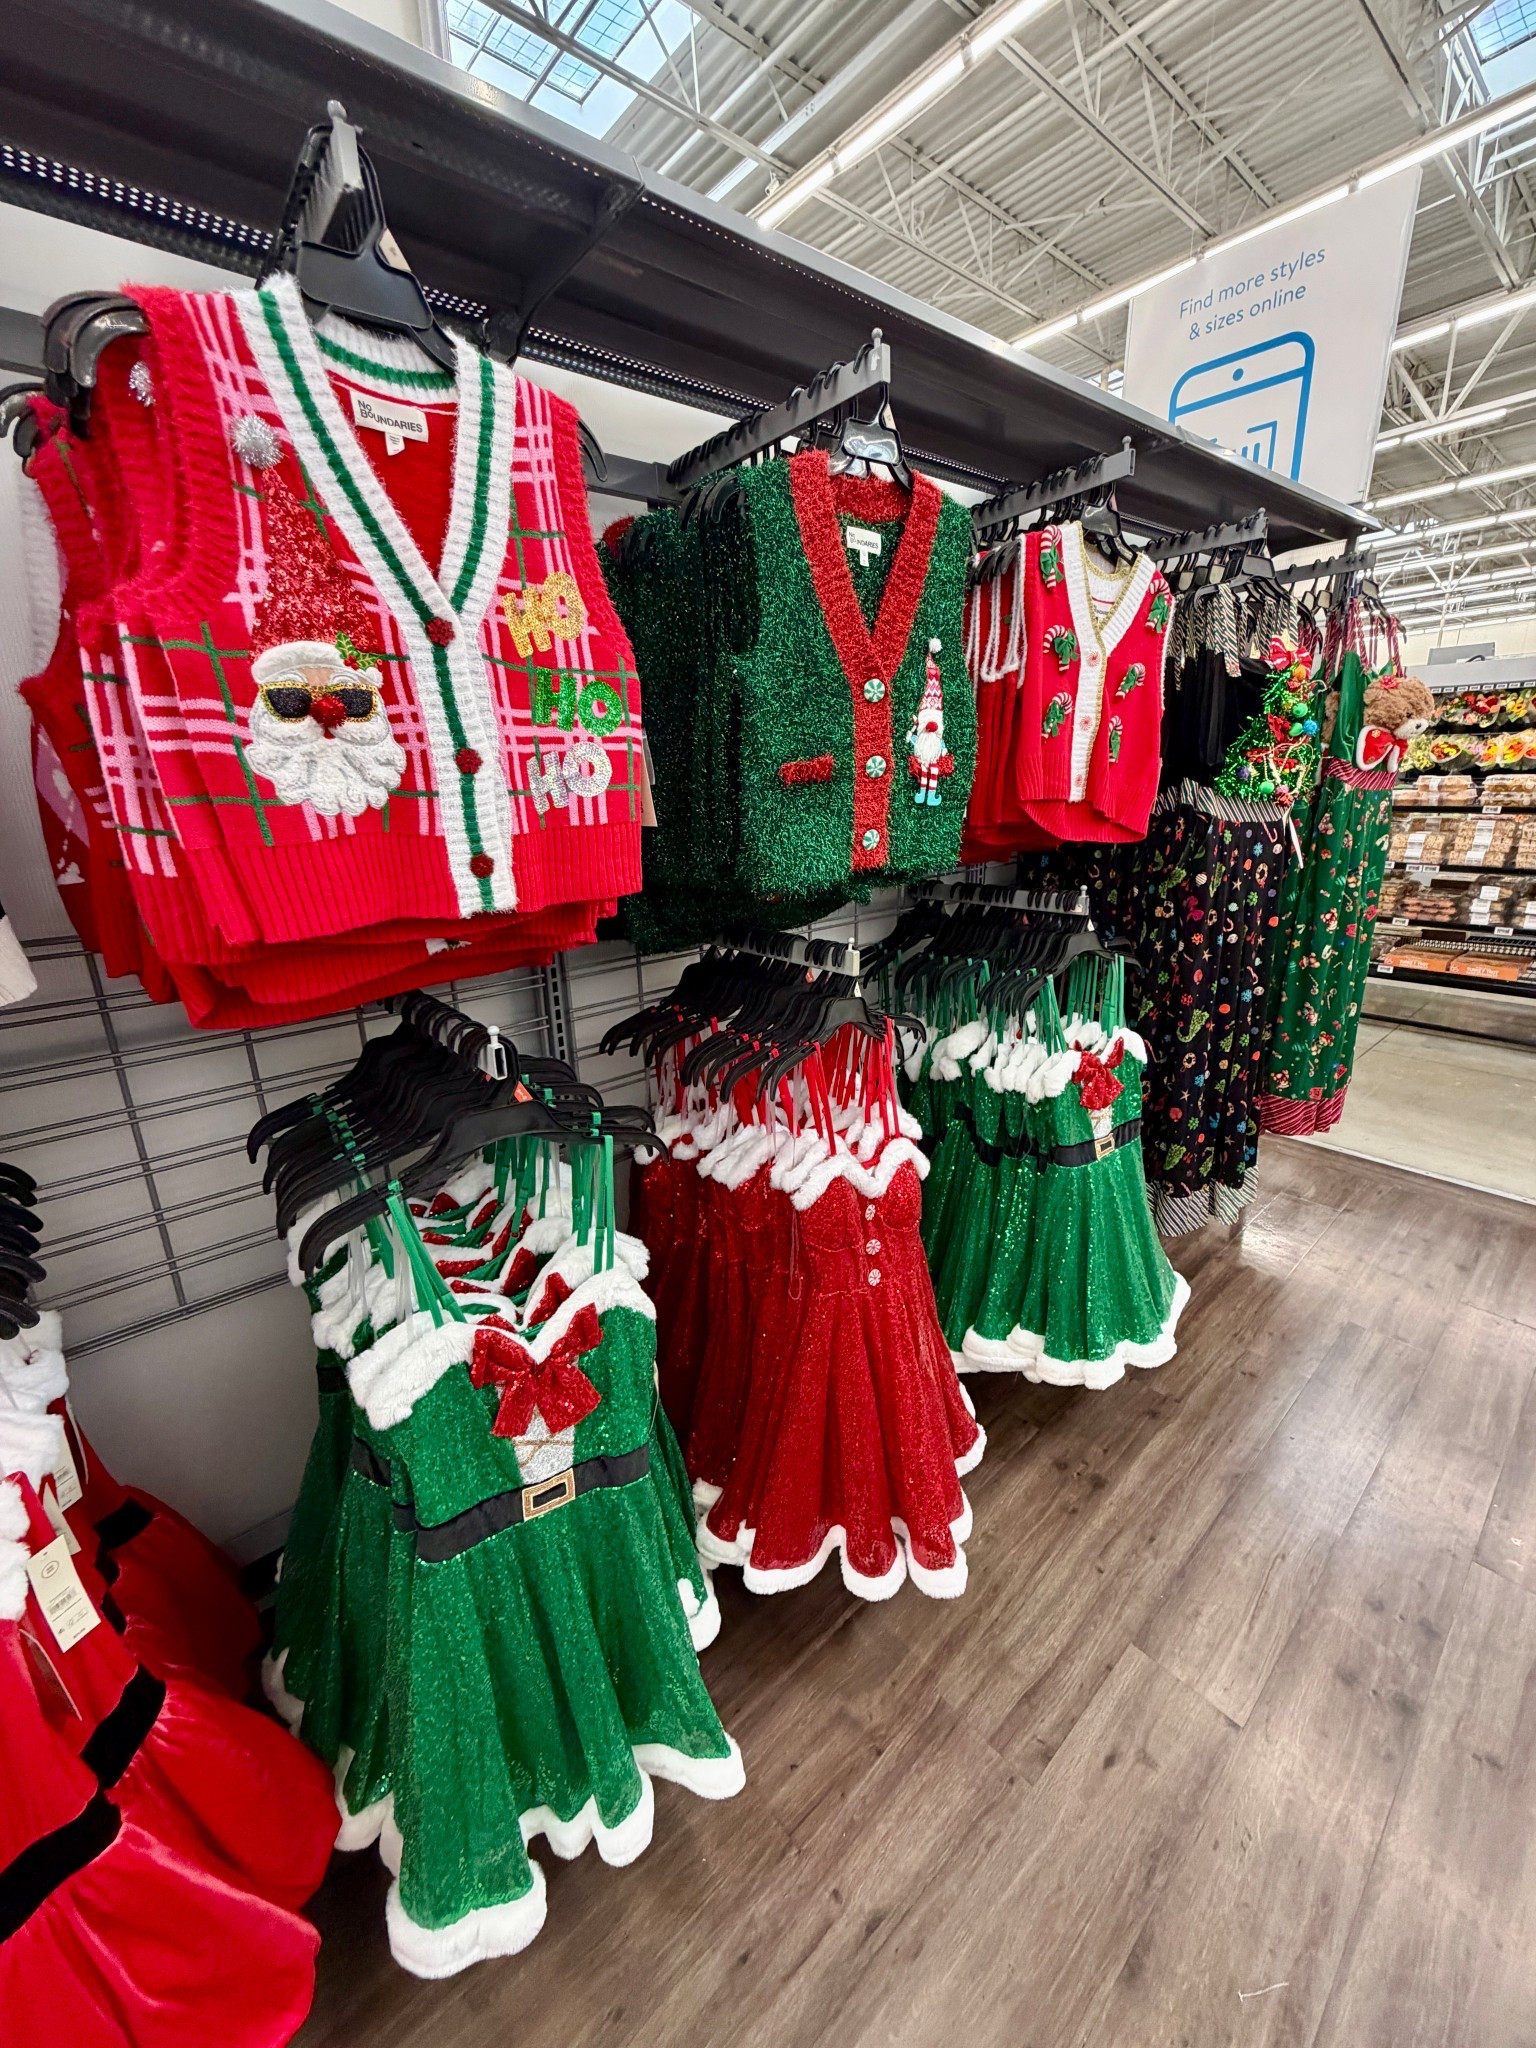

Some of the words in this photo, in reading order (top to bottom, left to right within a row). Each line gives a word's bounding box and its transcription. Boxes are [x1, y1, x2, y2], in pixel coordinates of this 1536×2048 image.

[1179, 289, 1214, 319] Find
[1218, 273, 1265, 302] more
[1270, 249, 1326, 281] styles
[1189, 322, 1200, 341] &
[1205, 309, 1244, 334] sizes
[1250, 285, 1307, 317] online
[360, 408, 423, 433] BOUNDARIES
[502, 570, 585, 659] HO
[535, 666, 623, 737] HO
[526, 741, 613, 815] HO
